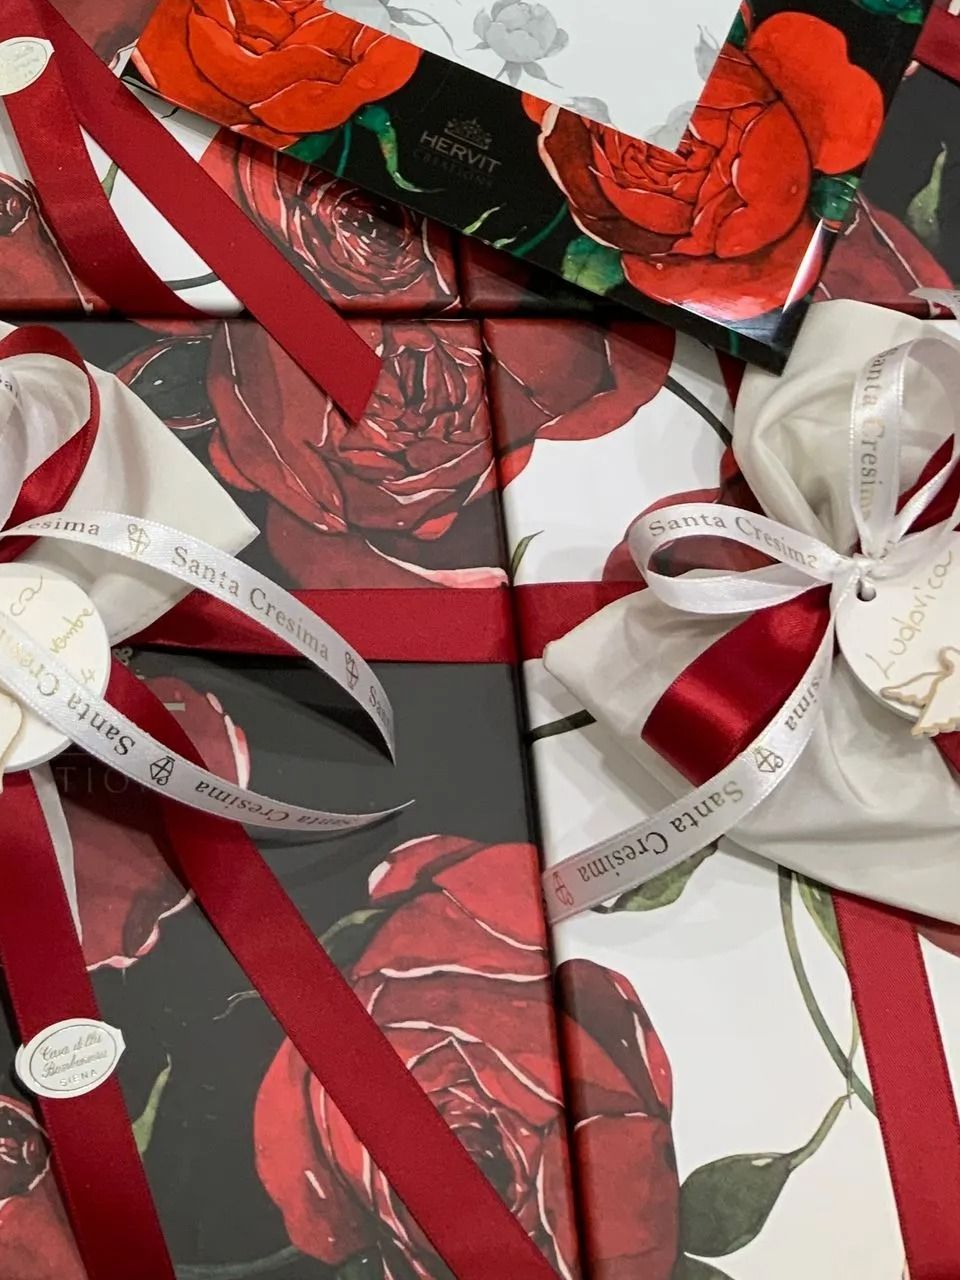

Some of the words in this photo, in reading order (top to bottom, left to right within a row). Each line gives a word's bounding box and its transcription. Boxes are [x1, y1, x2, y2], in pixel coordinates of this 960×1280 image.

[419, 129, 503, 174] HERVIT
[648, 512, 727, 538] Santa
[170, 546, 241, 598] Santa
[249, 587, 330, 663] Cresima
[864, 550, 953, 680] Ludovica
[66, 692, 137, 757] Santa
[194, 779, 290, 822] Cresima
[669, 779, 745, 834] Santa
[577, 830, 670, 883] Cresima
[58, 1069, 98, 1087] SIENA
